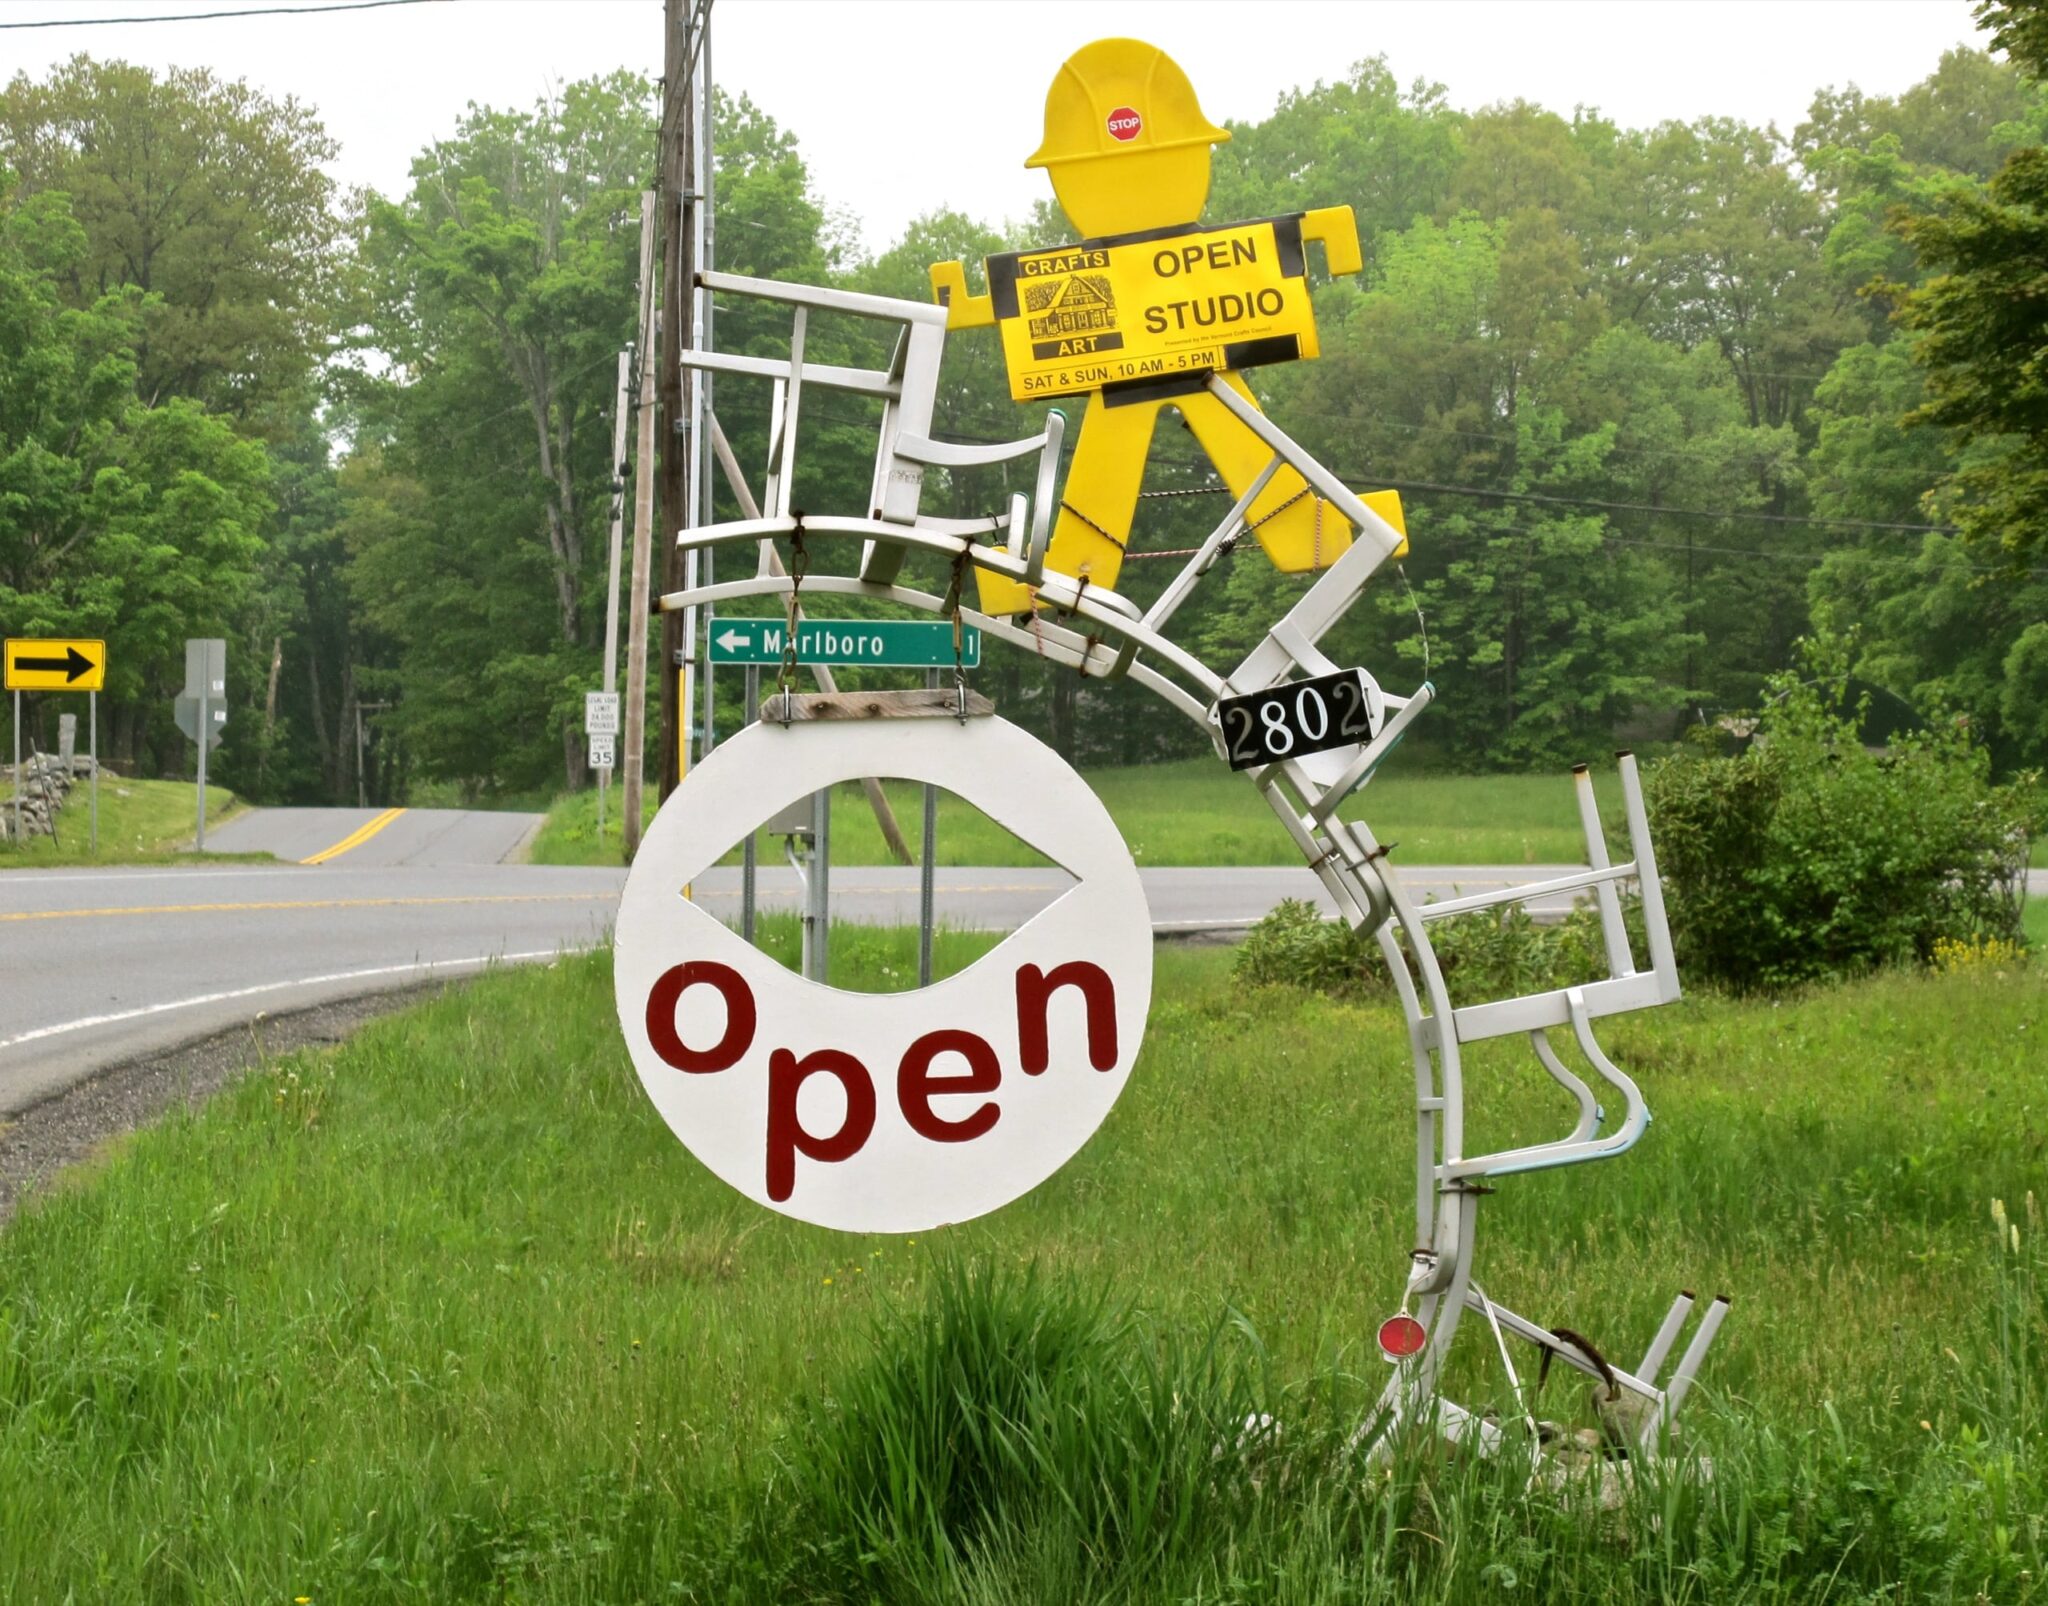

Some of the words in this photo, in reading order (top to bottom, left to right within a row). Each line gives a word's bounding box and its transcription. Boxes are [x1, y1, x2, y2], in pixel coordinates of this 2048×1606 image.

[1109, 117, 1139, 131] STOP
[1024, 253, 1105, 276] CRAFTS
[1153, 237, 1258, 278] OPEN
[1144, 288, 1284, 334] STUDIO
[1058, 337, 1098, 357] ART
[1023, 374, 1054, 390] SAT
[1059, 372, 1071, 386] &
[1075, 366, 1114, 383] SUN,
[1118, 363, 1135, 377] 10
[1139, 358, 1164, 373] AM
[1178, 356, 1188, 368] 5
[1191, 351, 1216, 366] PM
[967, 634, 974, 655] 1
[1225, 681, 1368, 762] 2802
[592, 752, 612, 764] 35
[645, 960, 1118, 1202] open
